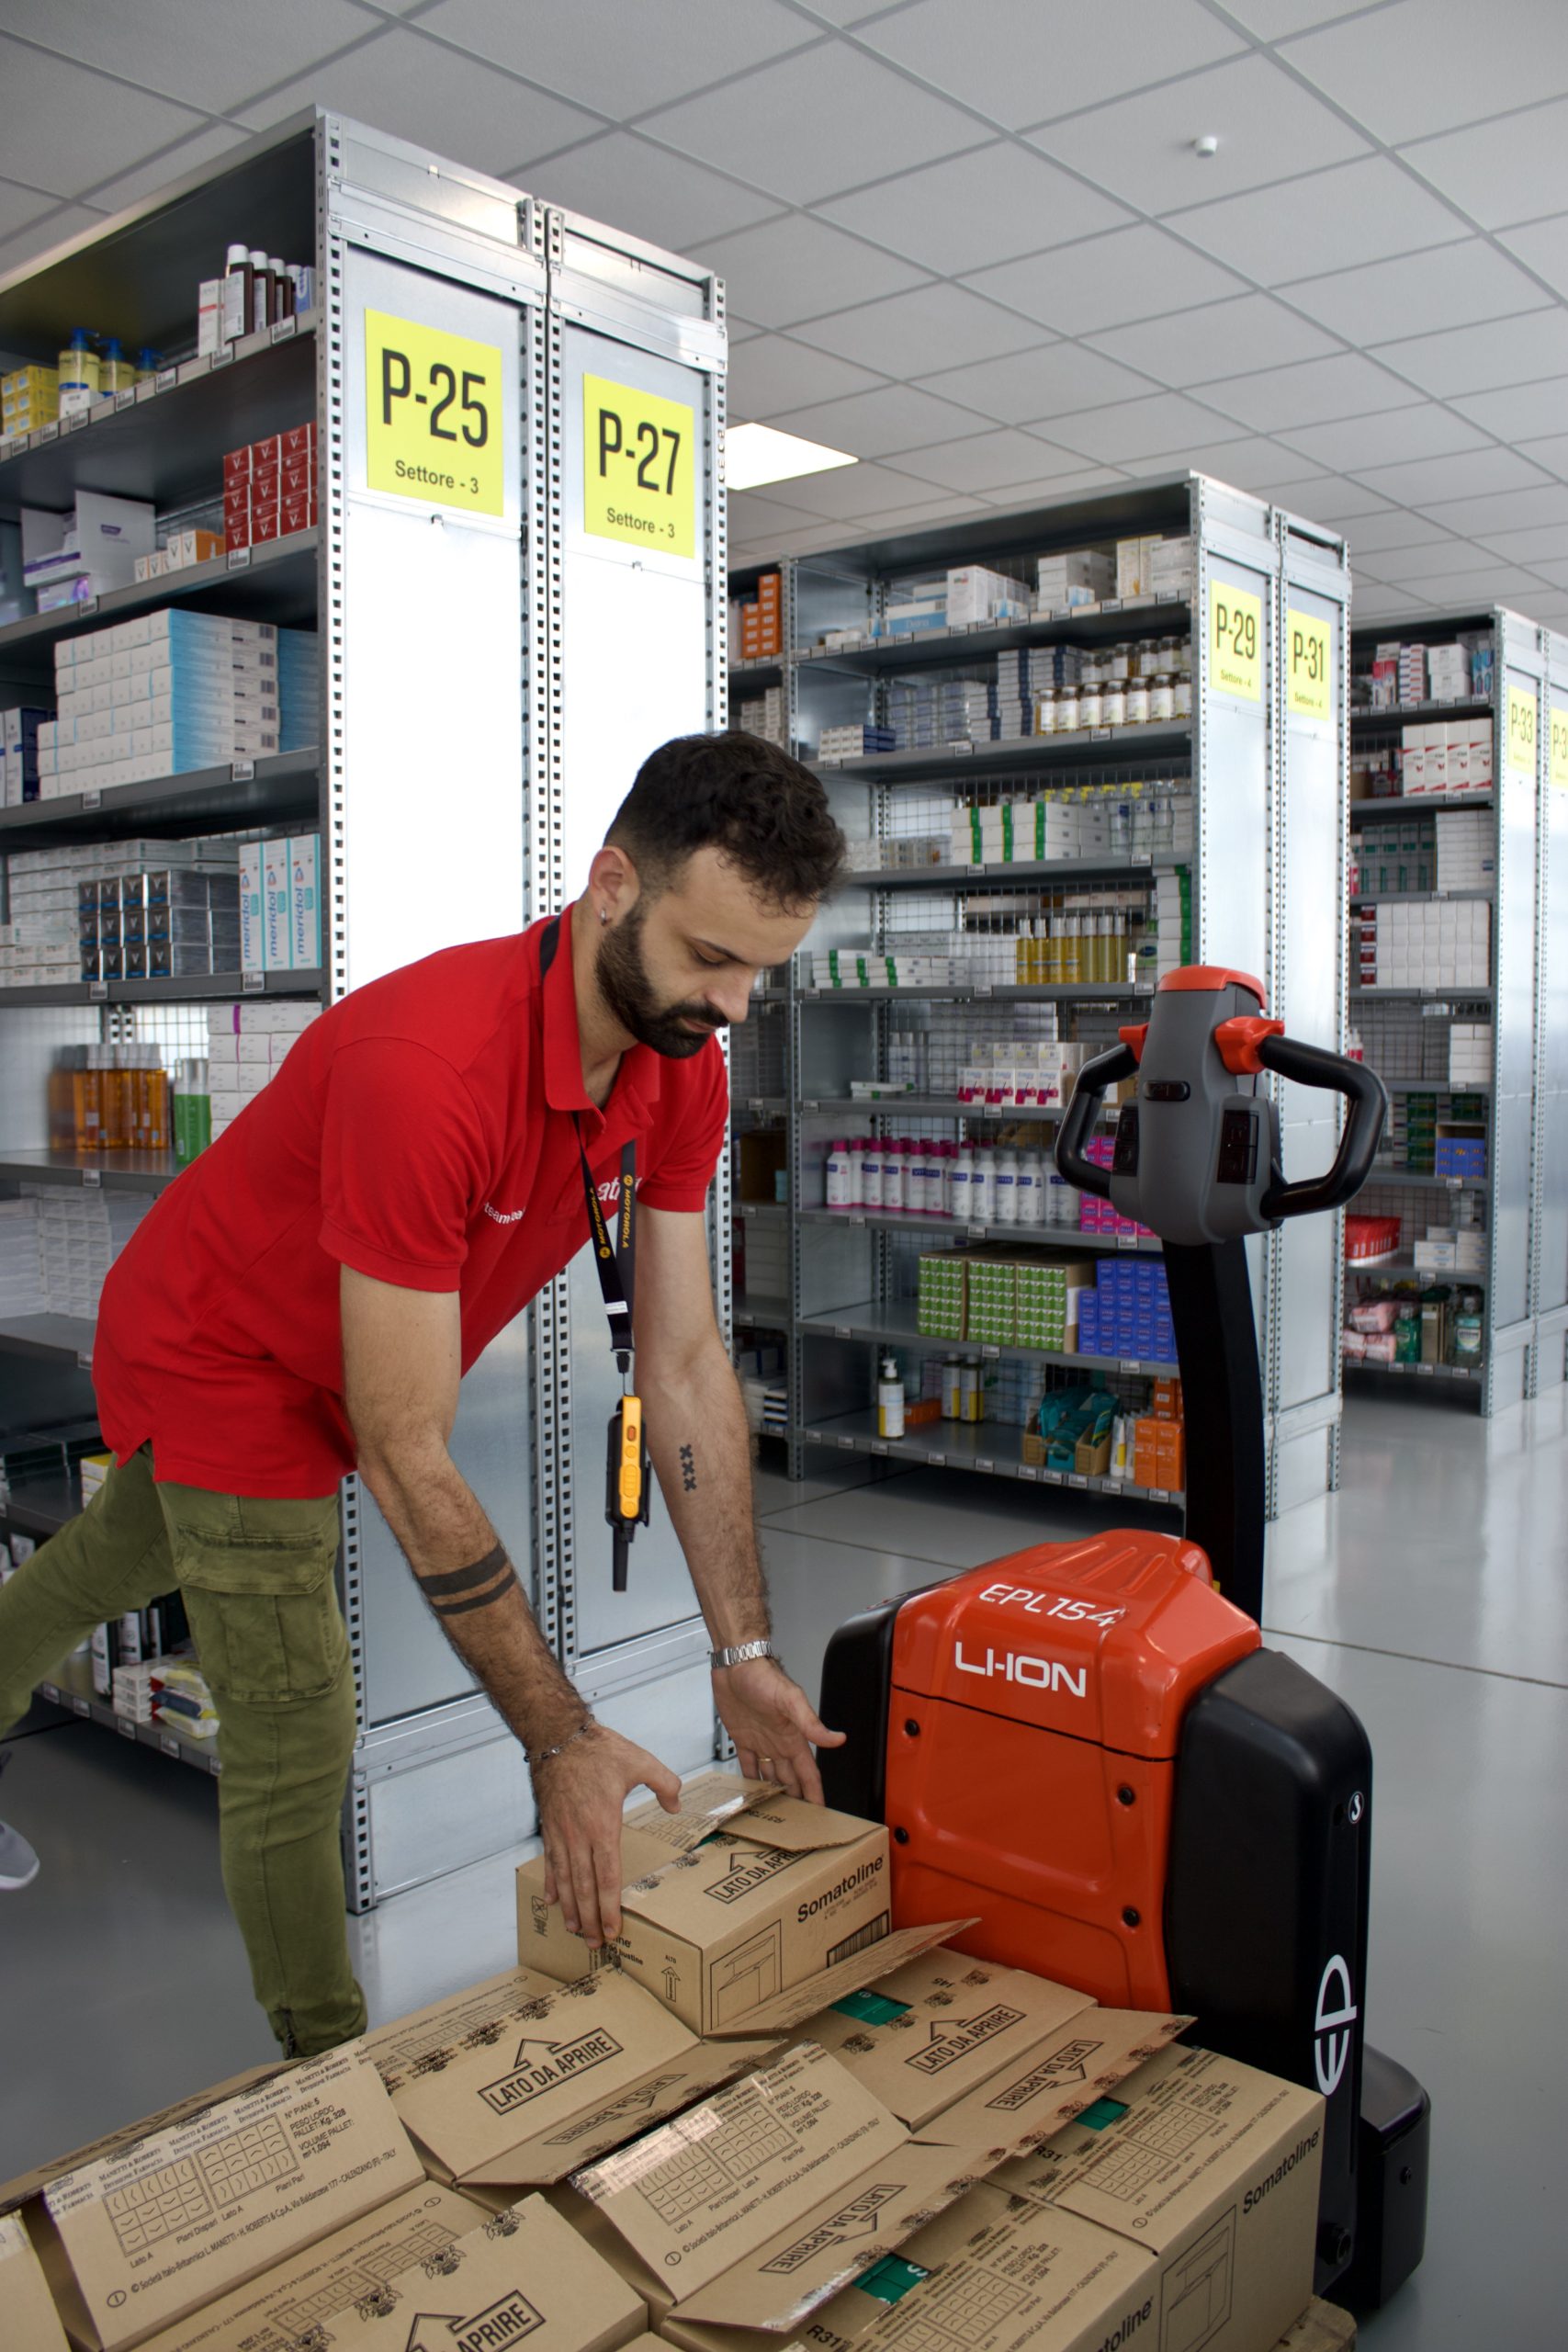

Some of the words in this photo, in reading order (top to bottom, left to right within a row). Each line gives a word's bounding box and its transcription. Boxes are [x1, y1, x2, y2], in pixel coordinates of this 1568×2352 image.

[382, 348, 488, 447] P-25
[599, 409, 681, 495] P-27
[395, 459, 455, 489] Settore
[470, 478, 479, 494] 3
[607, 507, 655, 534] Settore
[669, 524, 675, 538] 3
[1216, 602, 1255, 660] P-29
[1293, 630, 1323, 683] P-31
[1511, 703, 1533, 744] P-33
[1552, 724, 1568, 760] P-3
[242, 893, 251, 959] meridol
[267, 890, 277, 957] meridol
[295, 888, 305, 955] meridol
[621, 1188, 632, 1250] MOTOROLA
[955, 1641, 1087, 1698] LI-ION
[714, 1876, 751, 1899] LATO
[746, 1866, 772, 1880] DA
[797, 1856, 884, 1924] Somatoline
[917, 2045, 952, 2070] LATO
[949, 2034, 974, 2054] DA
[967, 2007, 1016, 2040] APRIRE
[1056, 2042, 1093, 2064] LATO
[490, 2077, 535, 2108] LATO
[530, 2064, 558, 2086] DA
[557, 2035, 613, 2074] APRIRE
[1041, 2063, 1066, 2075] DA
[996, 2075, 1047, 2107] APRIRE
[289, 2117, 310, 2131] PESO
[309, 2105, 335, 2122] LORDO
[298, 2132, 329, 2151] VOLUME
[1242, 2129, 1321, 2215] Somatoline
[855, 2188, 895, 2211] LATO
[175, 2232, 194, 2245] Piani
[194, 2218, 219, 2236] Dispari
[827, 2213, 858, 2229] DA
[130, 2257, 147, 2269] Lato
[772, 2230, 835, 2271] APRIRE
[1098, 2300, 1153, 2352] toline
